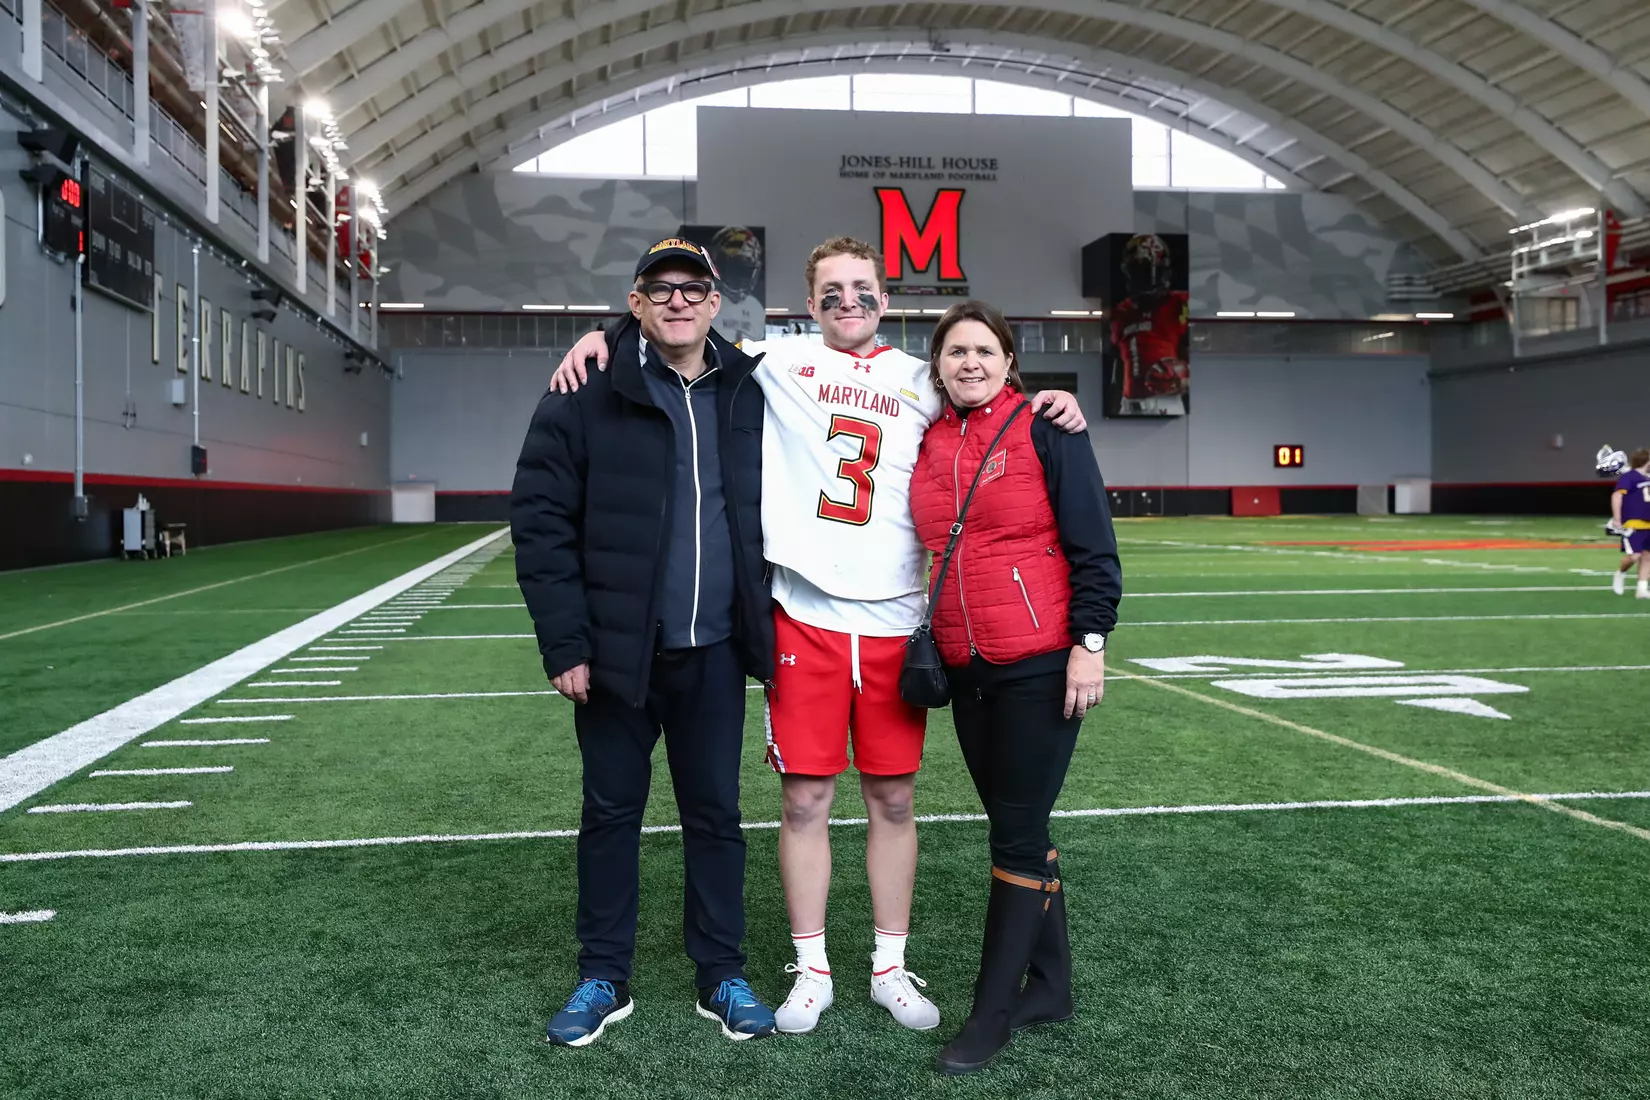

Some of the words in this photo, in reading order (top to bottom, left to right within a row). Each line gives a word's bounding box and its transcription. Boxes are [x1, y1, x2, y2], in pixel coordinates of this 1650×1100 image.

[839, 170, 869, 179] HOME
[873, 171, 886, 179] OF
[889, 171, 944, 181] MARYLAND
[948, 173, 998, 181] FOOTBALL
[840, 155, 935, 169] JONES-HILL
[942, 157, 998, 171] HOUSE
[873, 186, 967, 282] M
[152, 271, 305, 413] TERRAPINS
[817, 384, 900, 418] MARYLAND
[817, 413, 882, 526] 3
